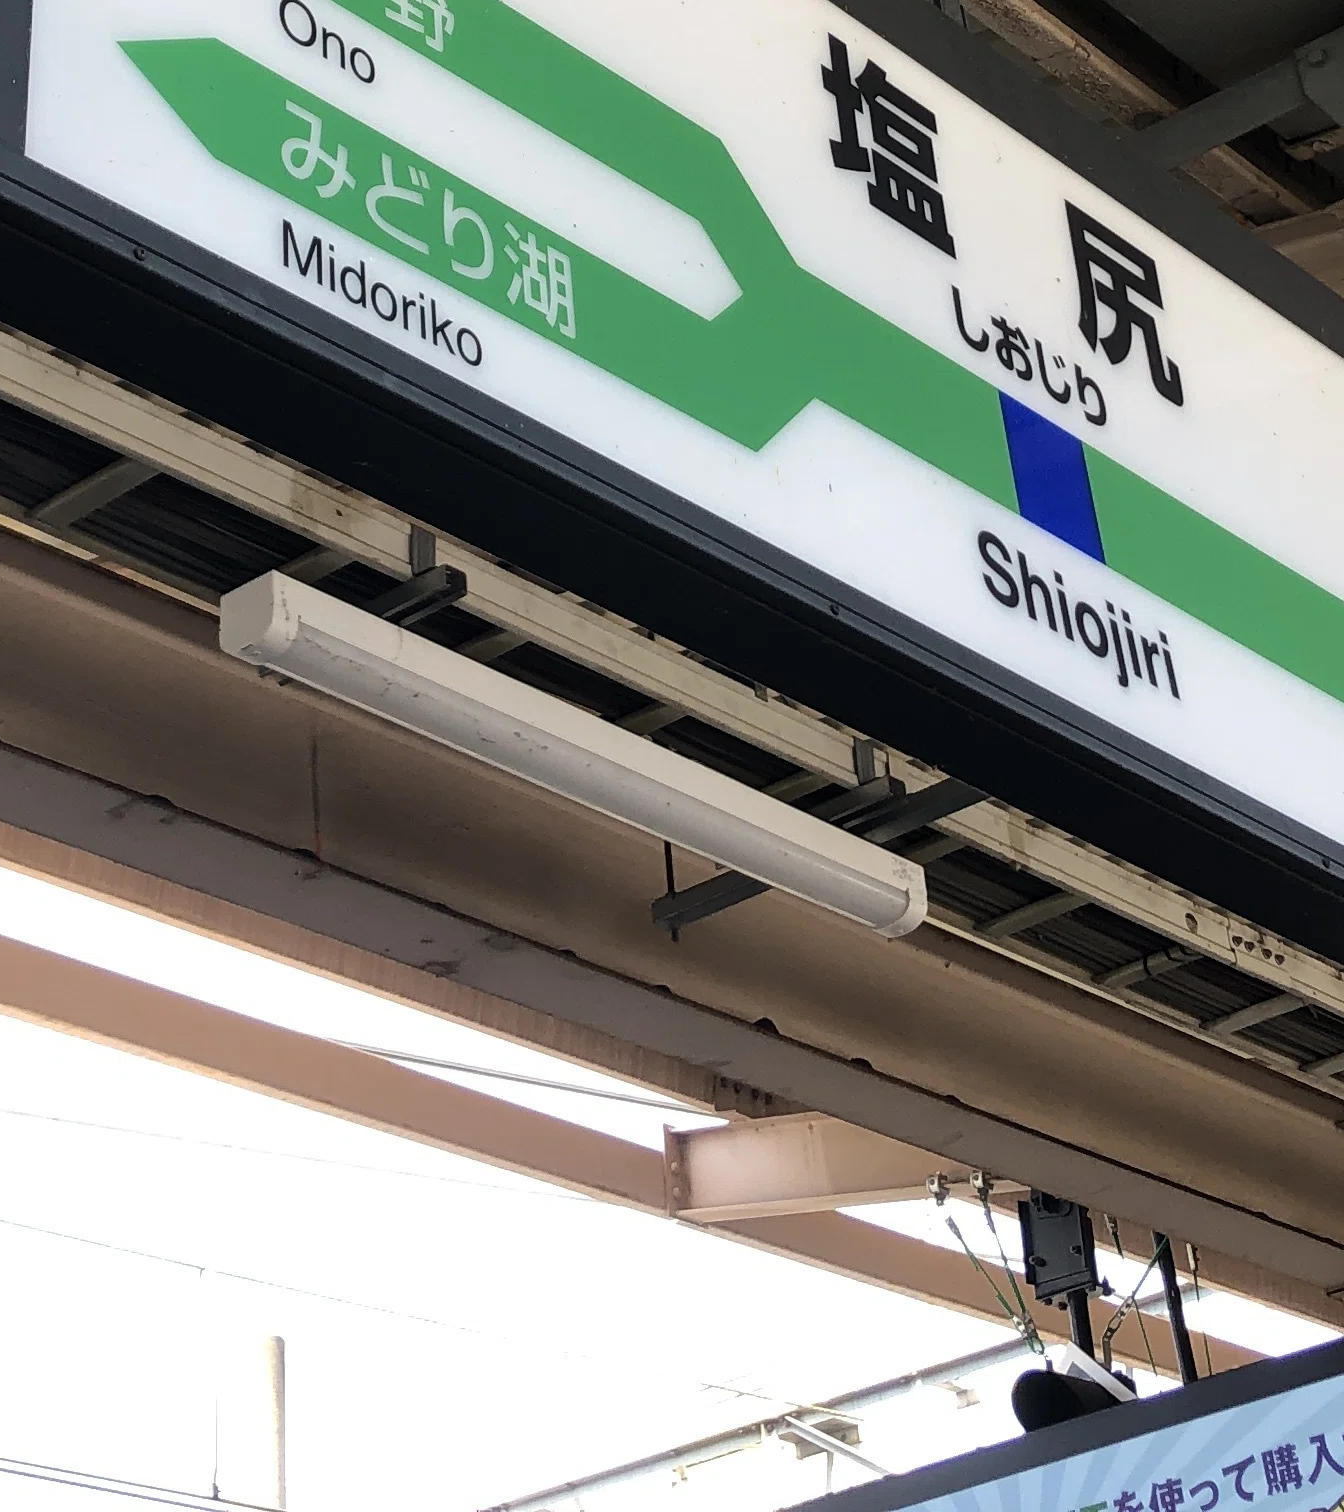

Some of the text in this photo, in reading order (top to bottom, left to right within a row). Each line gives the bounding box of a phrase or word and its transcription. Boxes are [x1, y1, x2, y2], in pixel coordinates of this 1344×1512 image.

[280, 100, 576, 339] みどり湖
[281, 219, 482, 366] Midoriko
[821, 33, 1184, 407] 塩尻
[951, 284, 1107, 426] しおじり
[977, 530, 1181, 700] Shiojiri
